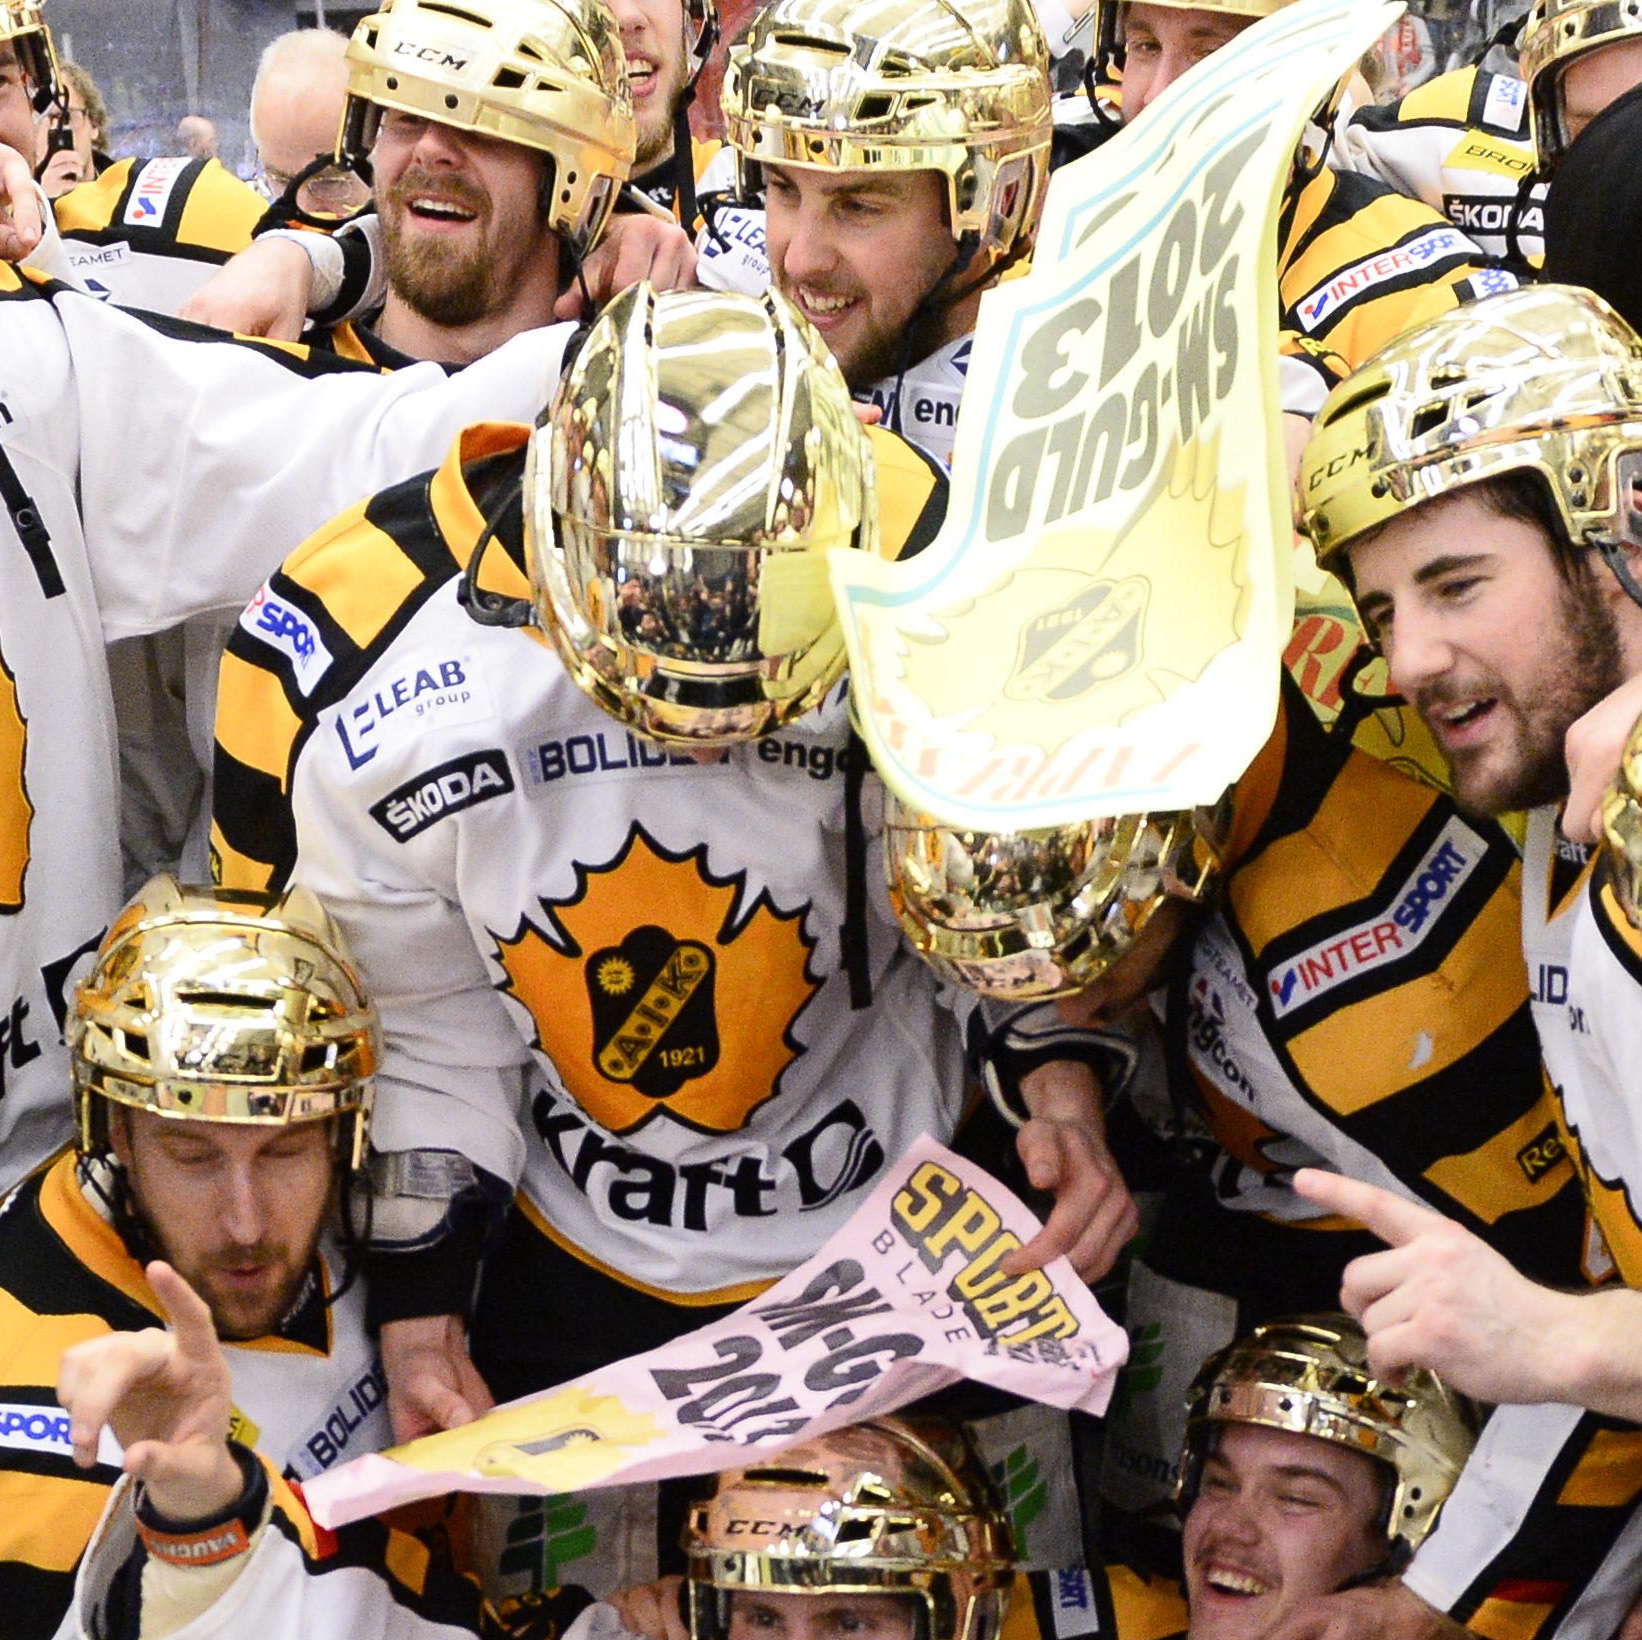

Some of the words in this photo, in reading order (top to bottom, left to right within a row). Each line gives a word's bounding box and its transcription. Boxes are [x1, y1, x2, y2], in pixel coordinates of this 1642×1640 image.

[394, 42, 466, 71] CCM
[1464, 143, 1531, 173] BRO
[1013, 122, 1267, 419] 2013
[985, 253, 1242, 544] SM-GULD
[1308, 442, 1376, 490] CCM
[415, 690, 471, 718] group
[384, 760, 505, 835] ŠKODA
[658, 1043, 706, 1070] 1921
[531, 1088, 778, 1232] kraft
